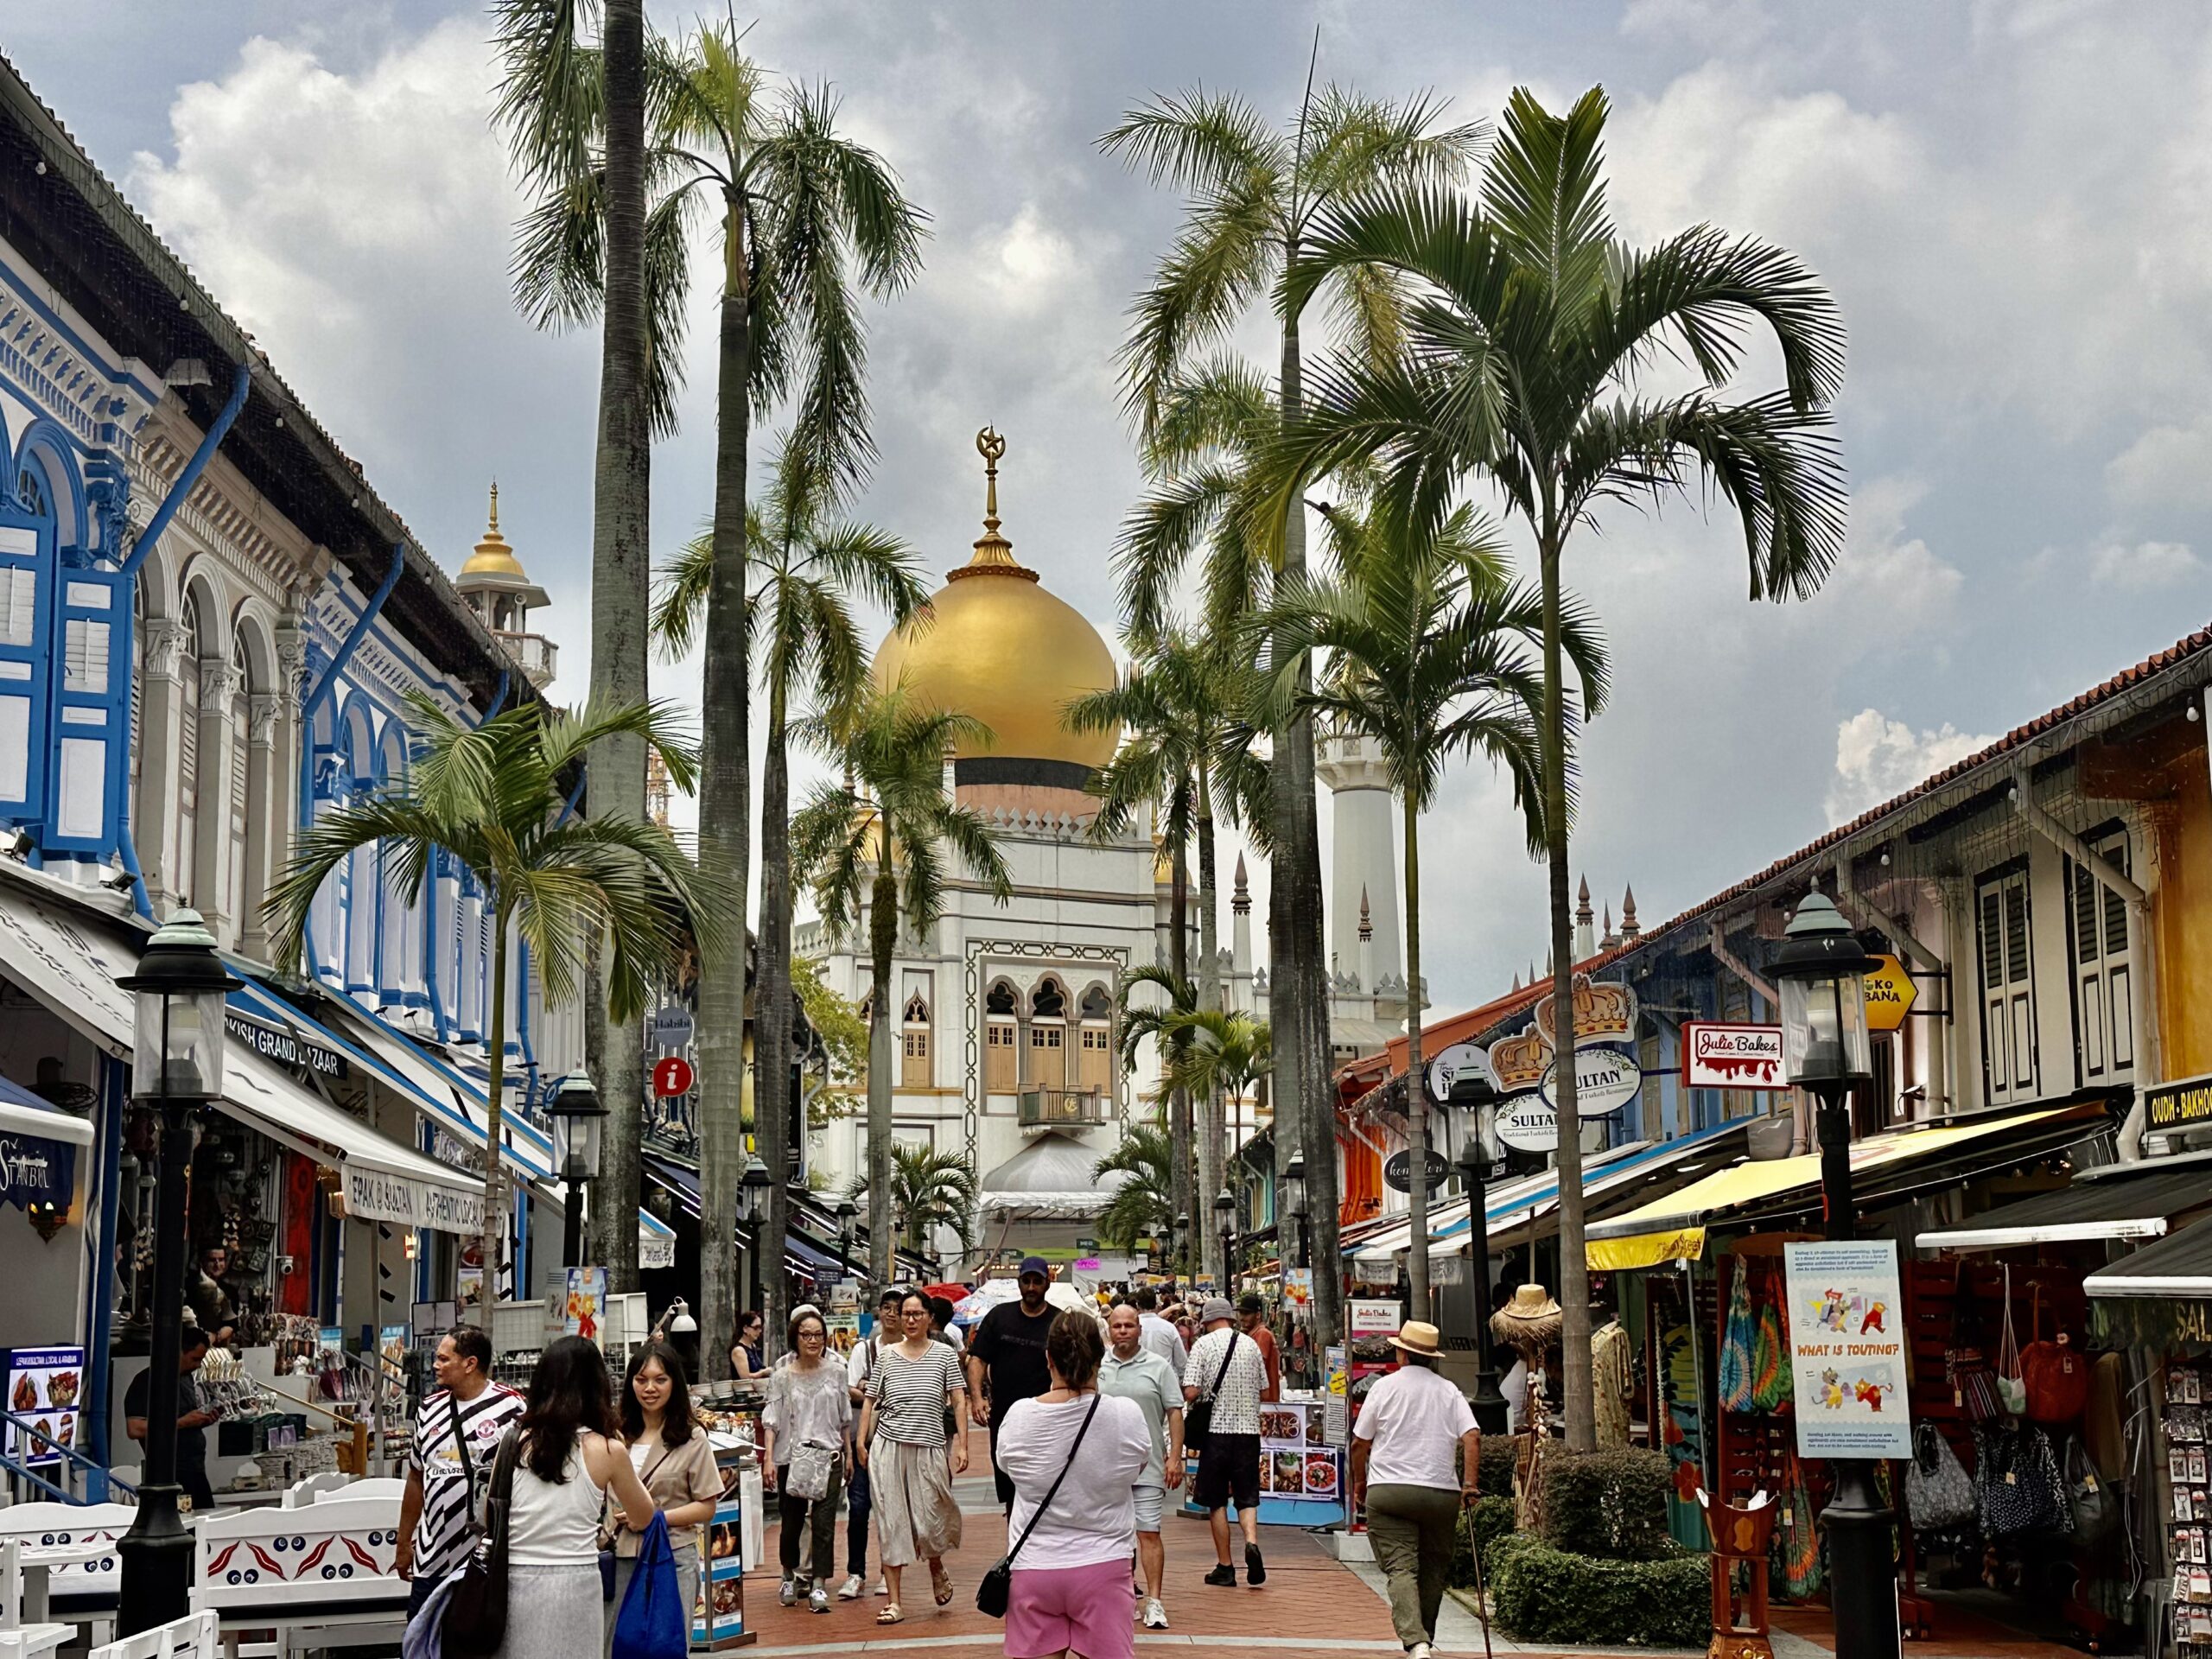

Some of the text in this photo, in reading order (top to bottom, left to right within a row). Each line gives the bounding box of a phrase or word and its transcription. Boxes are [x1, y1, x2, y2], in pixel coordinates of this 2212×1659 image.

[258, 1030, 296, 1062] GRAND
[1700, 1033, 1778, 1055] Julie Bakes
[2152, 1094, 2176, 1124] OUDH
[1797, 1344, 1830, 1357] WHAT
[1833, 1344, 1843, 1356] IS
